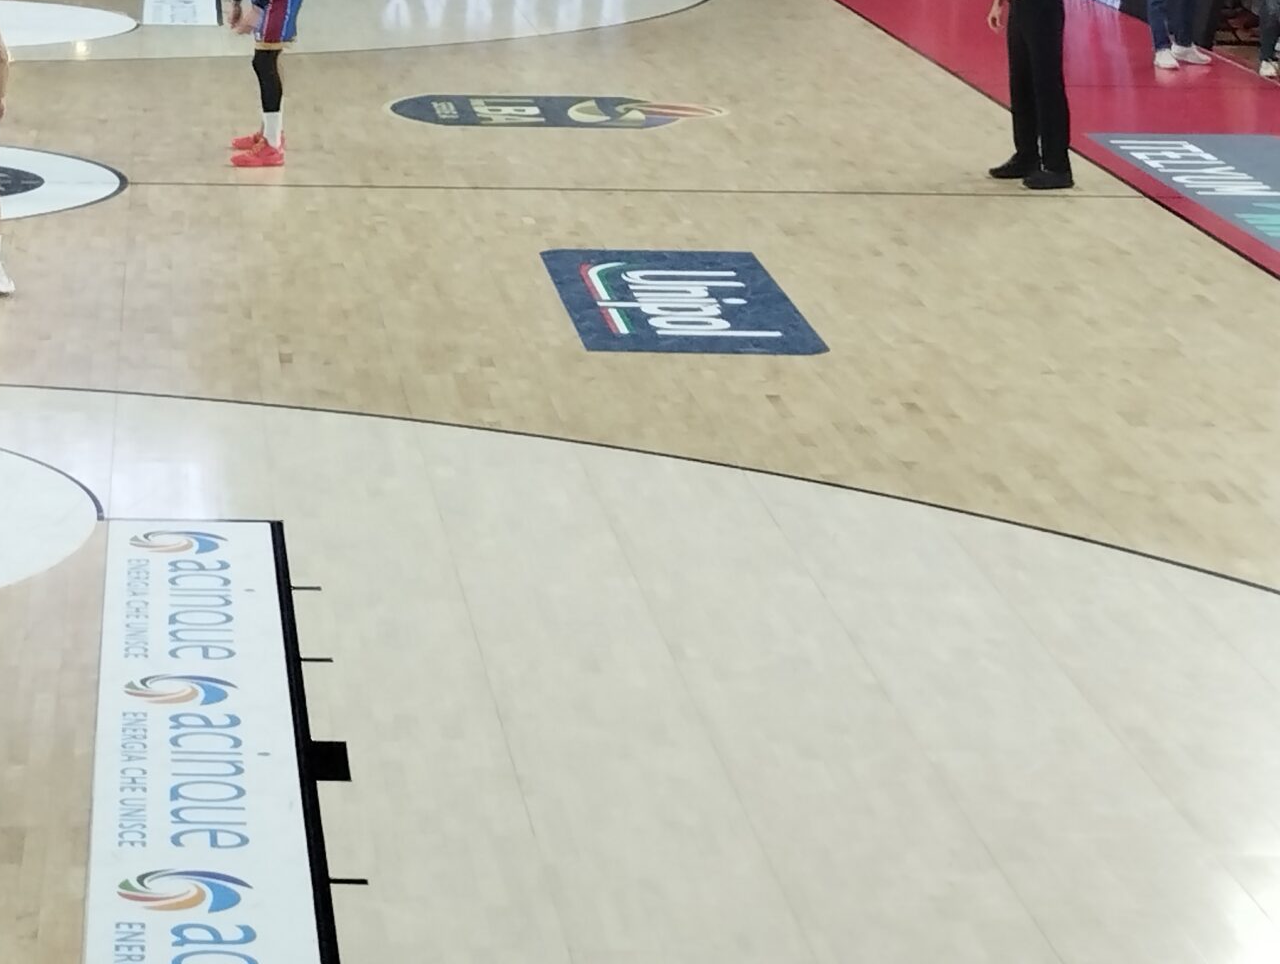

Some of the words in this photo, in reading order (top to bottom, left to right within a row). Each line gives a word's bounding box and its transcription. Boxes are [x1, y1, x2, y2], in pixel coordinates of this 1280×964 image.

[596, 270, 783, 337] Unipol
[127, 558, 150, 597] ENERGIA
[125, 599, 149, 619] CHE
[167, 559, 255, 660] acinque
[123, 622, 149, 658] UNISCE
[121, 711, 148, 762] ENERGIA
[120, 767, 148, 793] CHE
[169, 712, 271, 849] acinque
[118, 798, 148, 847] UNISCE
